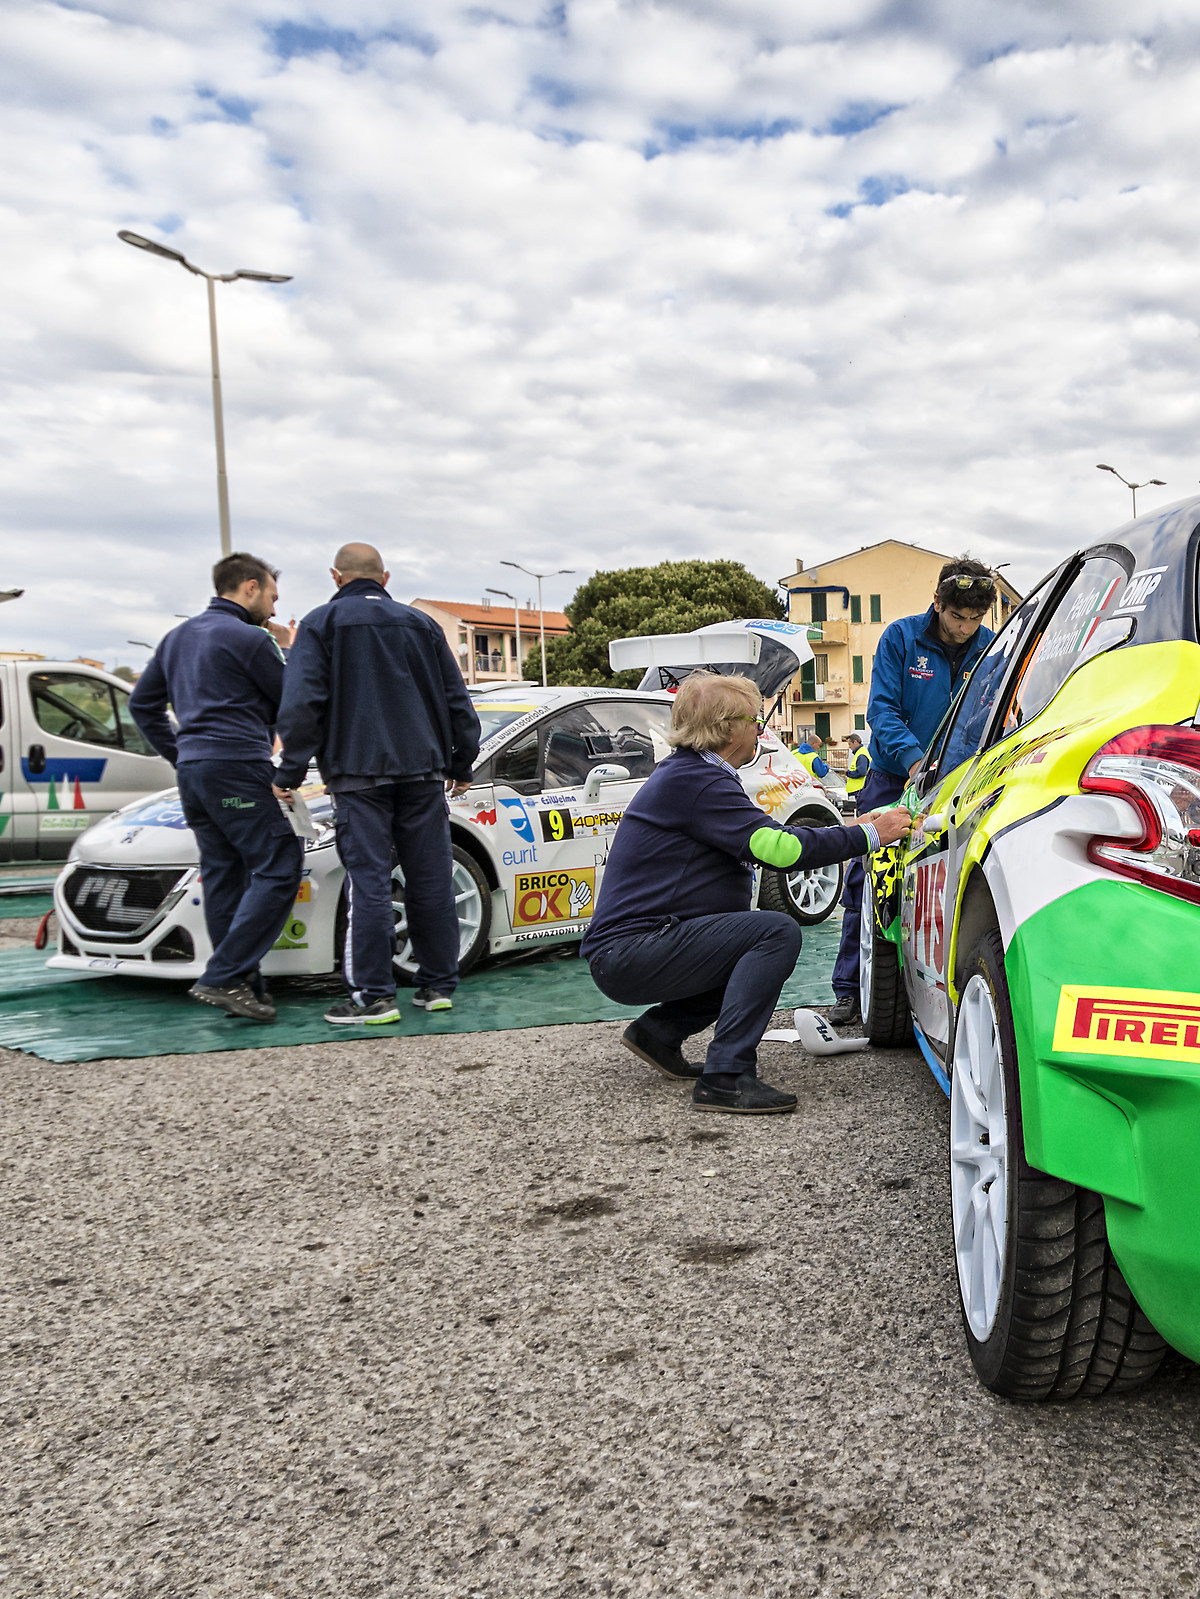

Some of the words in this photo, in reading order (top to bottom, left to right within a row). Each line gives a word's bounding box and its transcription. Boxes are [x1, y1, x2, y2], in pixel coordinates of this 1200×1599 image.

[1064, 587, 1100, 623] Pedro
[1119, 574, 1161, 608] OMP
[549, 810, 564, 840] 9
[502, 845, 538, 866] eurit
[519, 874, 569, 891] BRICO
[518, 888, 564, 922] OK
[515, 926, 575, 942] ESCAVAZIONI
